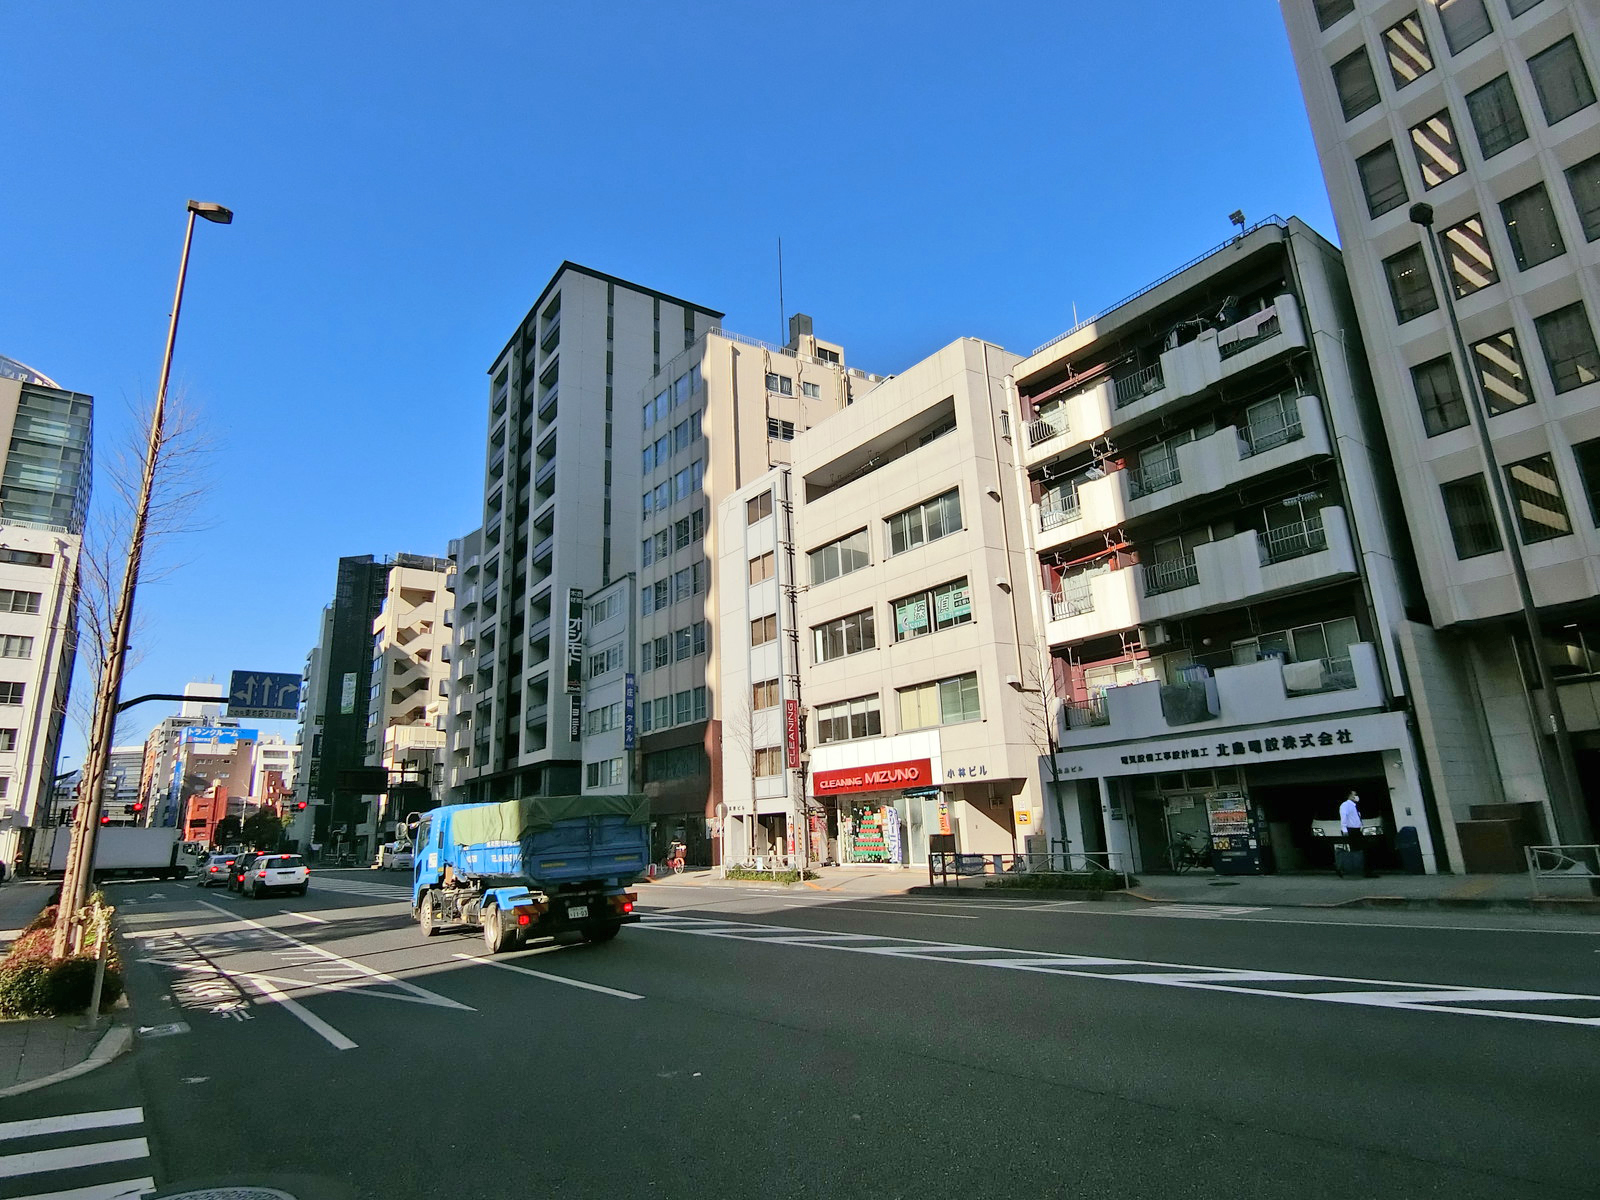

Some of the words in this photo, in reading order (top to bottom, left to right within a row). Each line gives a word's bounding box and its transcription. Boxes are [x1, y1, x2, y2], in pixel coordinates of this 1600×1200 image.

[188, 728, 239, 737] トランクルーム
[787, 702, 796, 765] CLEANING
[1216, 729, 1353, 757] 北島電設株式会社
[1120, 747, 1209, 765] 電気設備工事設計施工
[820, 776, 863, 790] CLEANING
[864, 767, 920, 784] MIZUNO
[947, 765, 988, 780] 小林ビル
